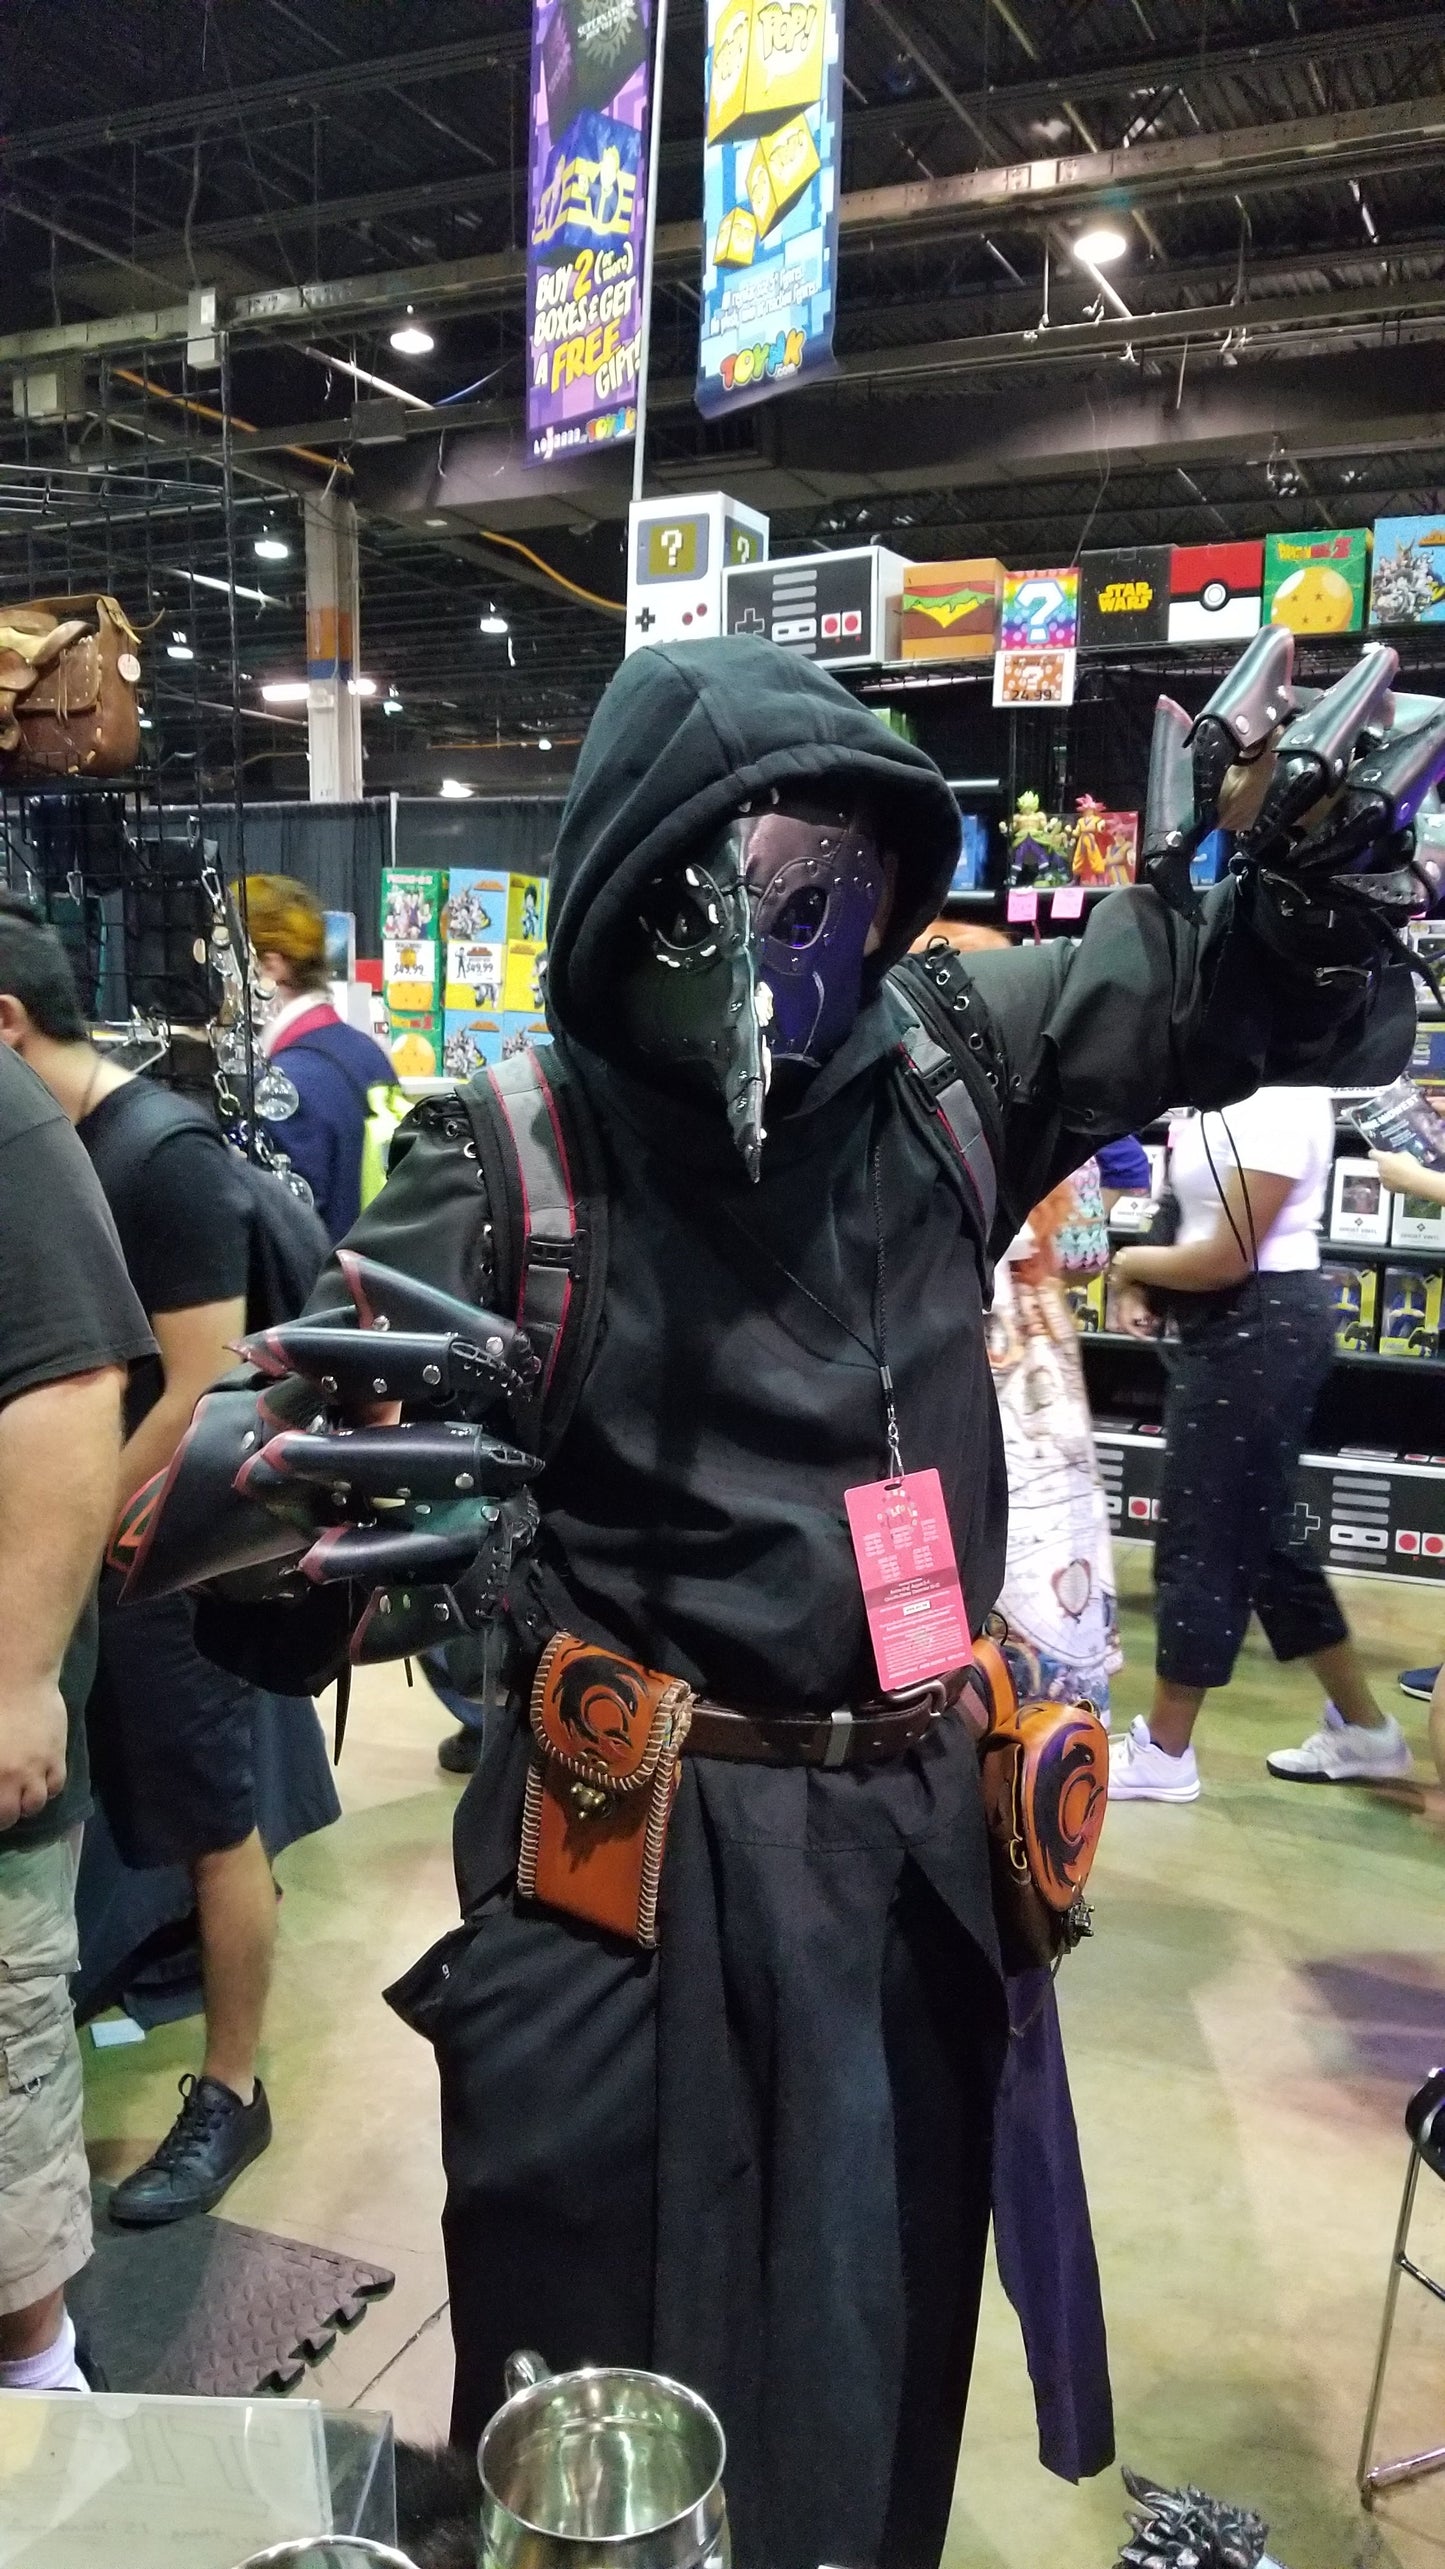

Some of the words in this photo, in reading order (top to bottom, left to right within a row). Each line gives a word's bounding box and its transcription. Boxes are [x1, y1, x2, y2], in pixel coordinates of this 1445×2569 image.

[757, 1, 817, 61] POP!
[535, 263, 573, 310] BUY
[573, 248, 594, 304] 2
[533, 295, 588, 347] BOXES
[599, 275, 637, 322] GET
[534, 352, 548, 385] A
[551, 317, 622, 394] FREE
[595, 328, 641, 399] GIFT!
[1098, 593, 1151, 613] WARS
[1104, 582, 1152, 600] STAR
[1011, 689, 1052, 701] 24.99
[466, 962, 494, 974] $49.99
[1376, 1093, 1419, 1126] MIDWEST
